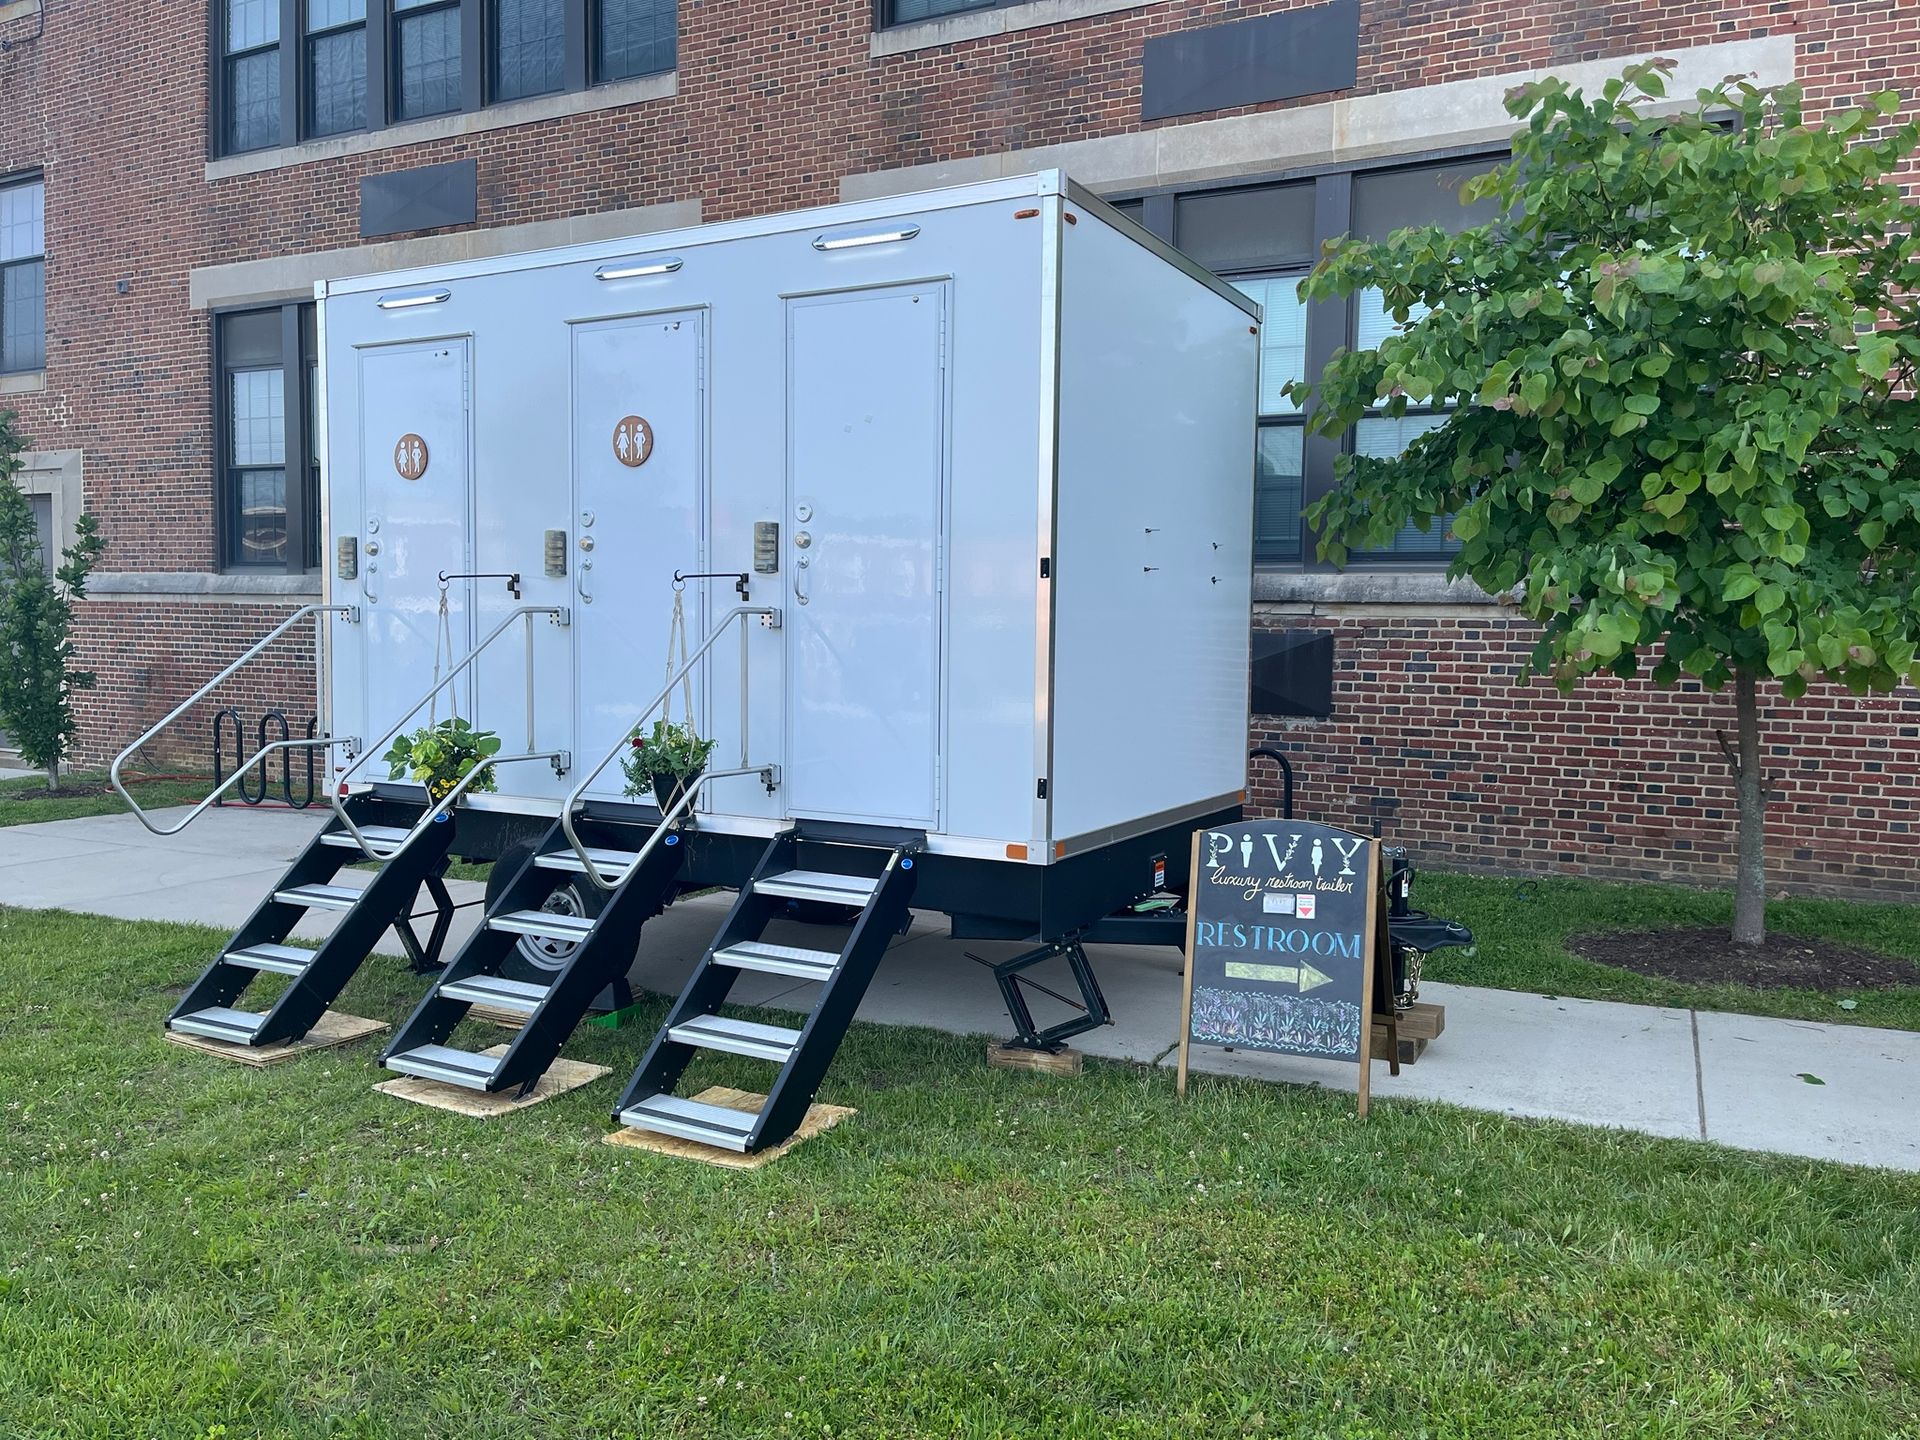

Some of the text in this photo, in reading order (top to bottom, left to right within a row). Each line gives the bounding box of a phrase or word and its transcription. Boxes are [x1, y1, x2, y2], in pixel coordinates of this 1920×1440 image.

[1210, 865, 1262, 901] luxury
[1265, 872, 1313, 891] restroom
[1315, 875, 1354, 894] trailer
[1197, 921, 1361, 959] RESTROOM
